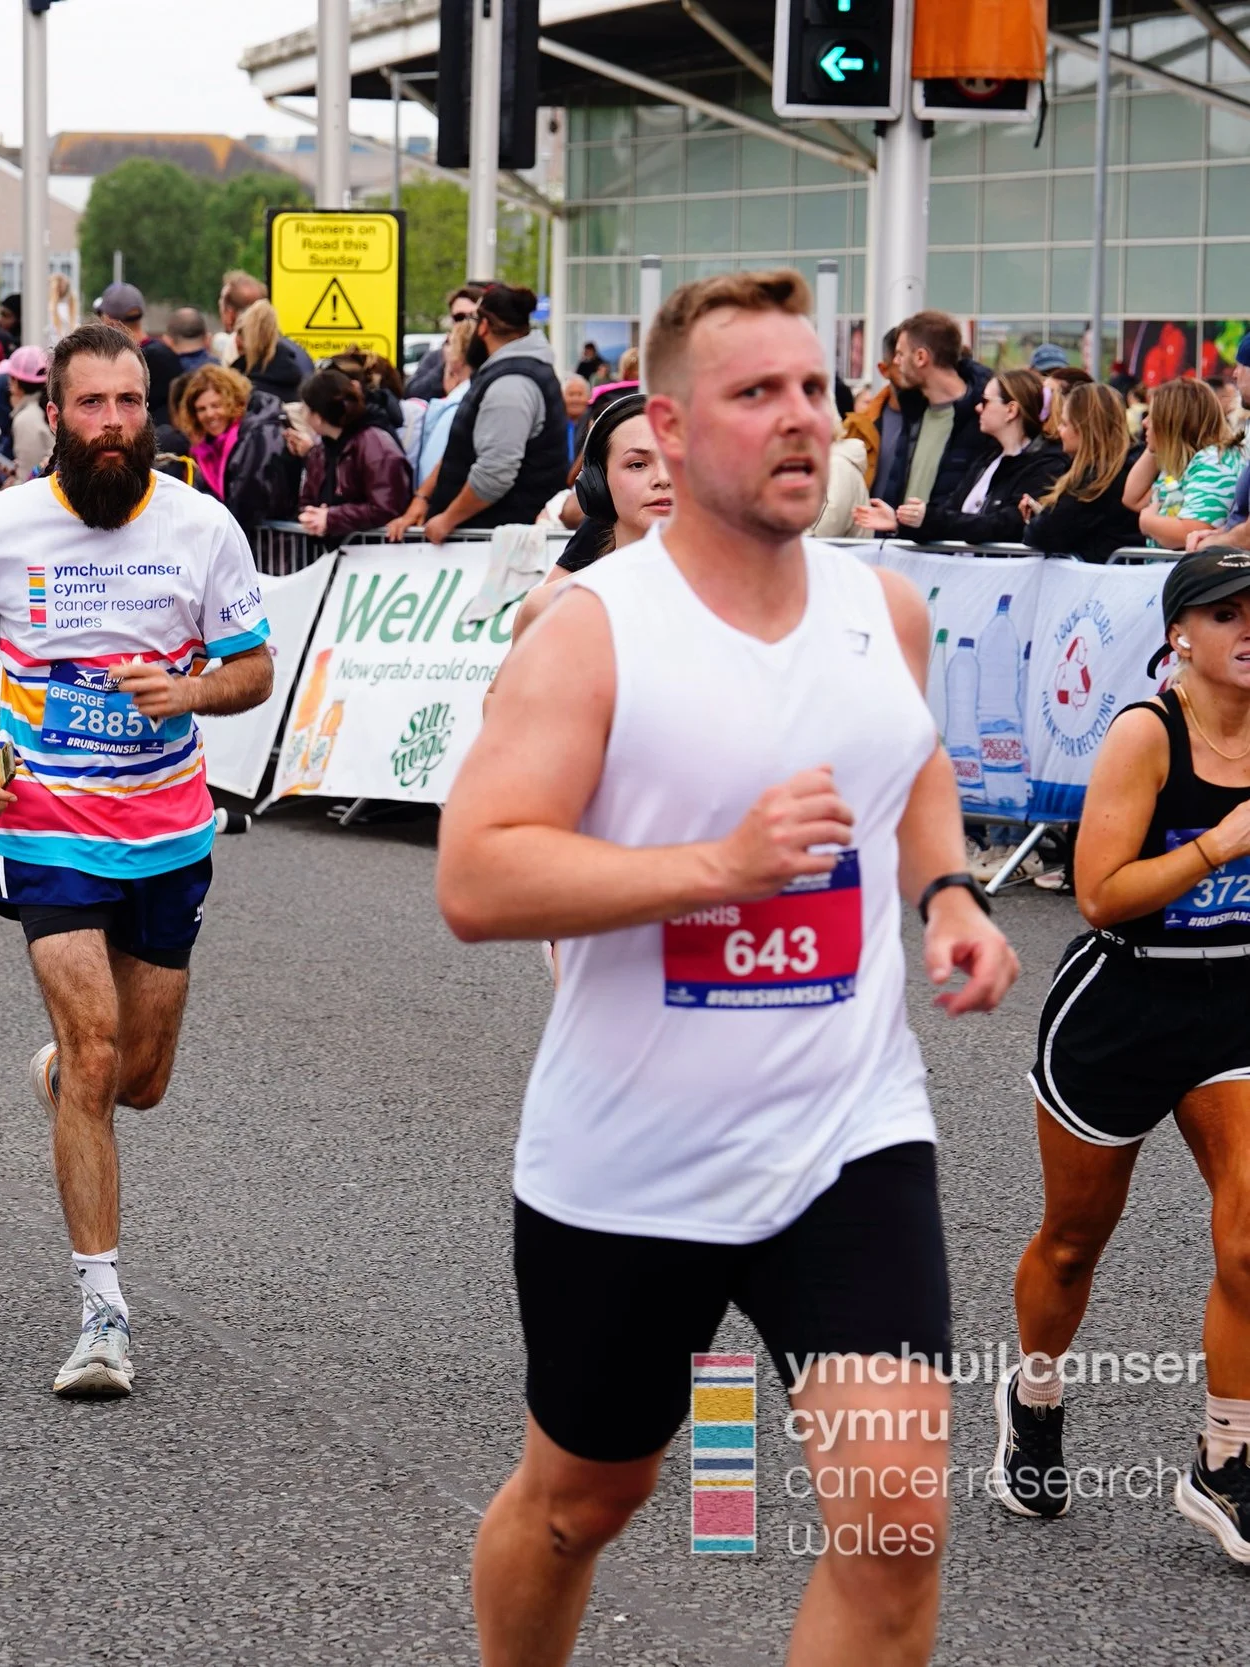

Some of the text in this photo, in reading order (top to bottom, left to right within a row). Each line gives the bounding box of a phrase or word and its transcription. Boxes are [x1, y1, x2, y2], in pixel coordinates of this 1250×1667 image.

[295, 222, 376, 235] Runners on
[302, 238, 369, 250] Road this
[309, 254, 361, 268] Sunday
[54, 563, 181, 579] ymchwil canser
[54, 581, 106, 596] cymru
[55, 596, 175, 612] cancer research
[335, 568, 463, 643] Well
[55, 615, 102, 629] wales
[336, 657, 374, 680] Now
[370, 656, 412, 686] grab
[412, 663, 425, 680] a
[426, 657, 468, 681] cold
[50, 686, 106, 709] GEORGE
[69, 705, 143, 737] 2885
[67, 737, 141, 754] #RUNSWANSEA
[724, 926, 819, 976] 643
